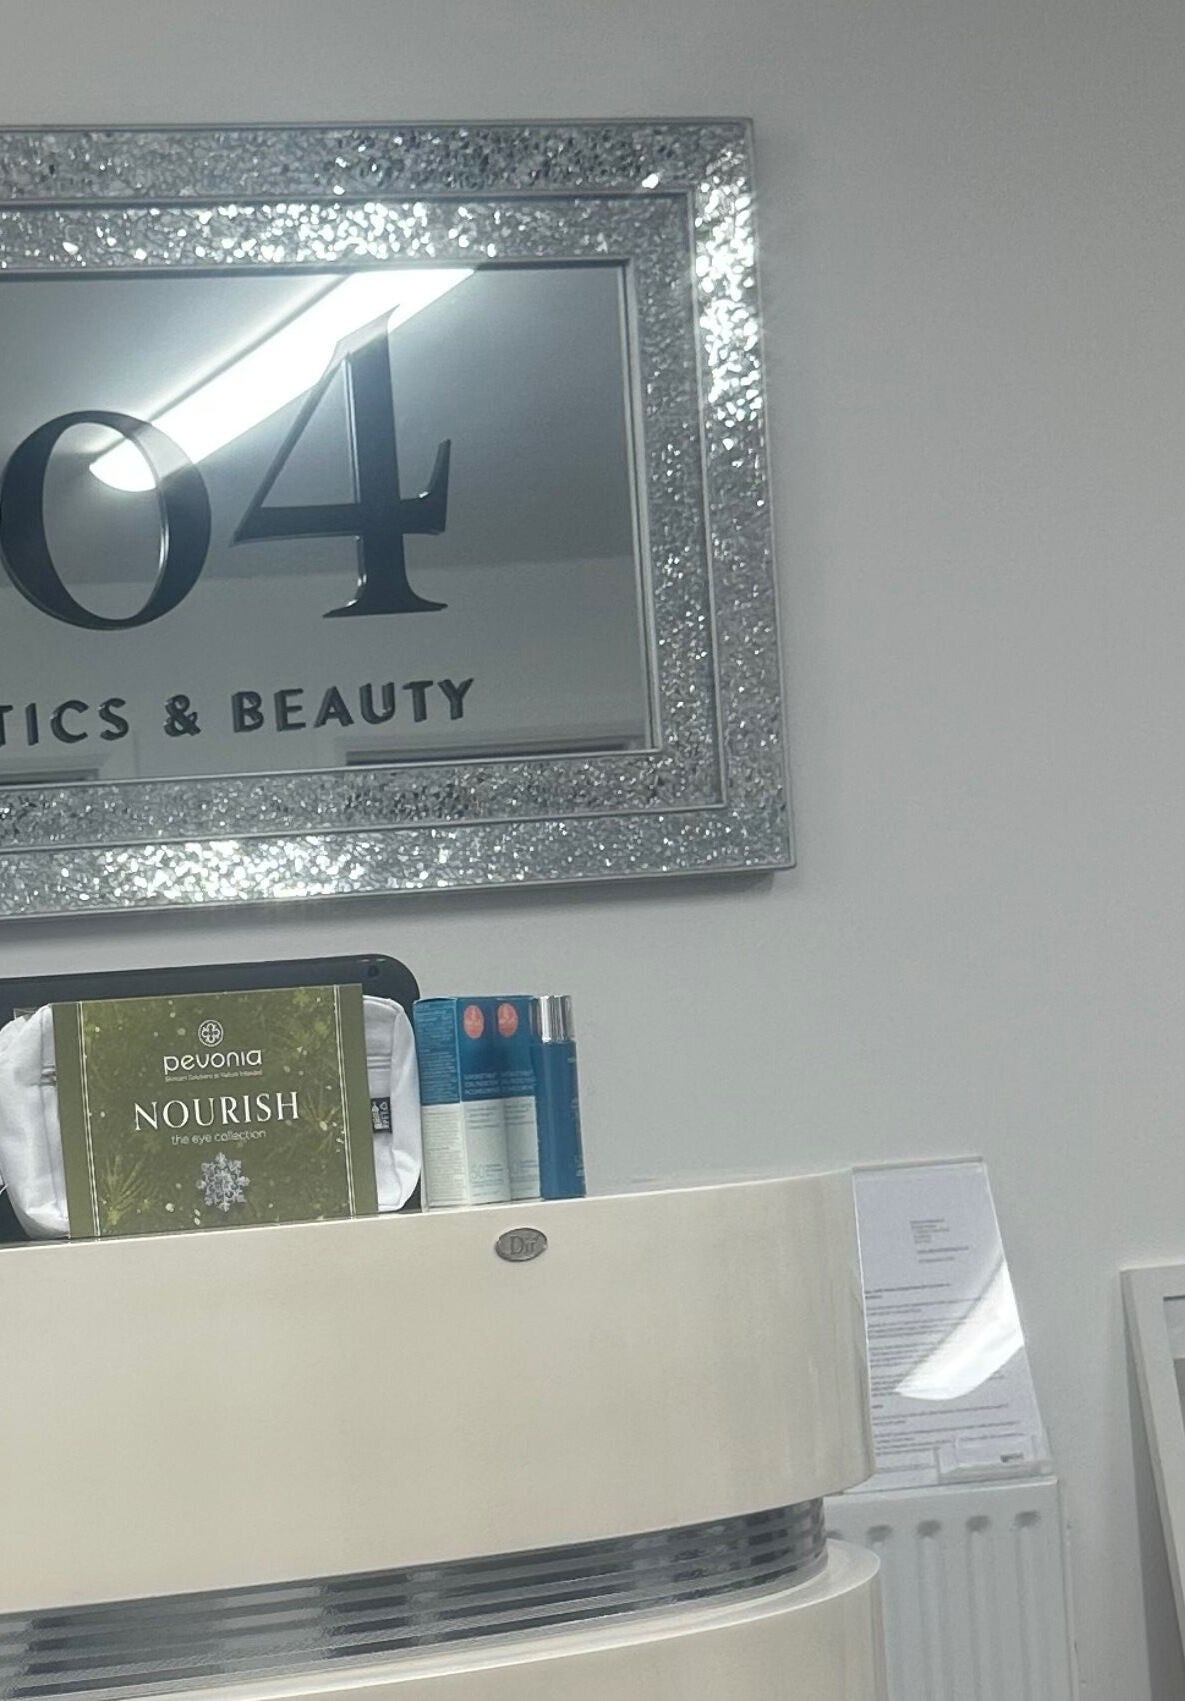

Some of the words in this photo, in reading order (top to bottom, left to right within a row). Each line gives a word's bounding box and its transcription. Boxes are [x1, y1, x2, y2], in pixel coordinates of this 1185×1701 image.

[162, 693, 201, 738] &
[230, 676, 476, 734] BEAUTY
[163, 1050, 263, 1075] pevonia
[133, 1091, 300, 1131] NOURISH
[171, 1134, 190, 1145] the
[192, 1134, 212, 1146] eye
[214, 1130, 266, 1142] collection
